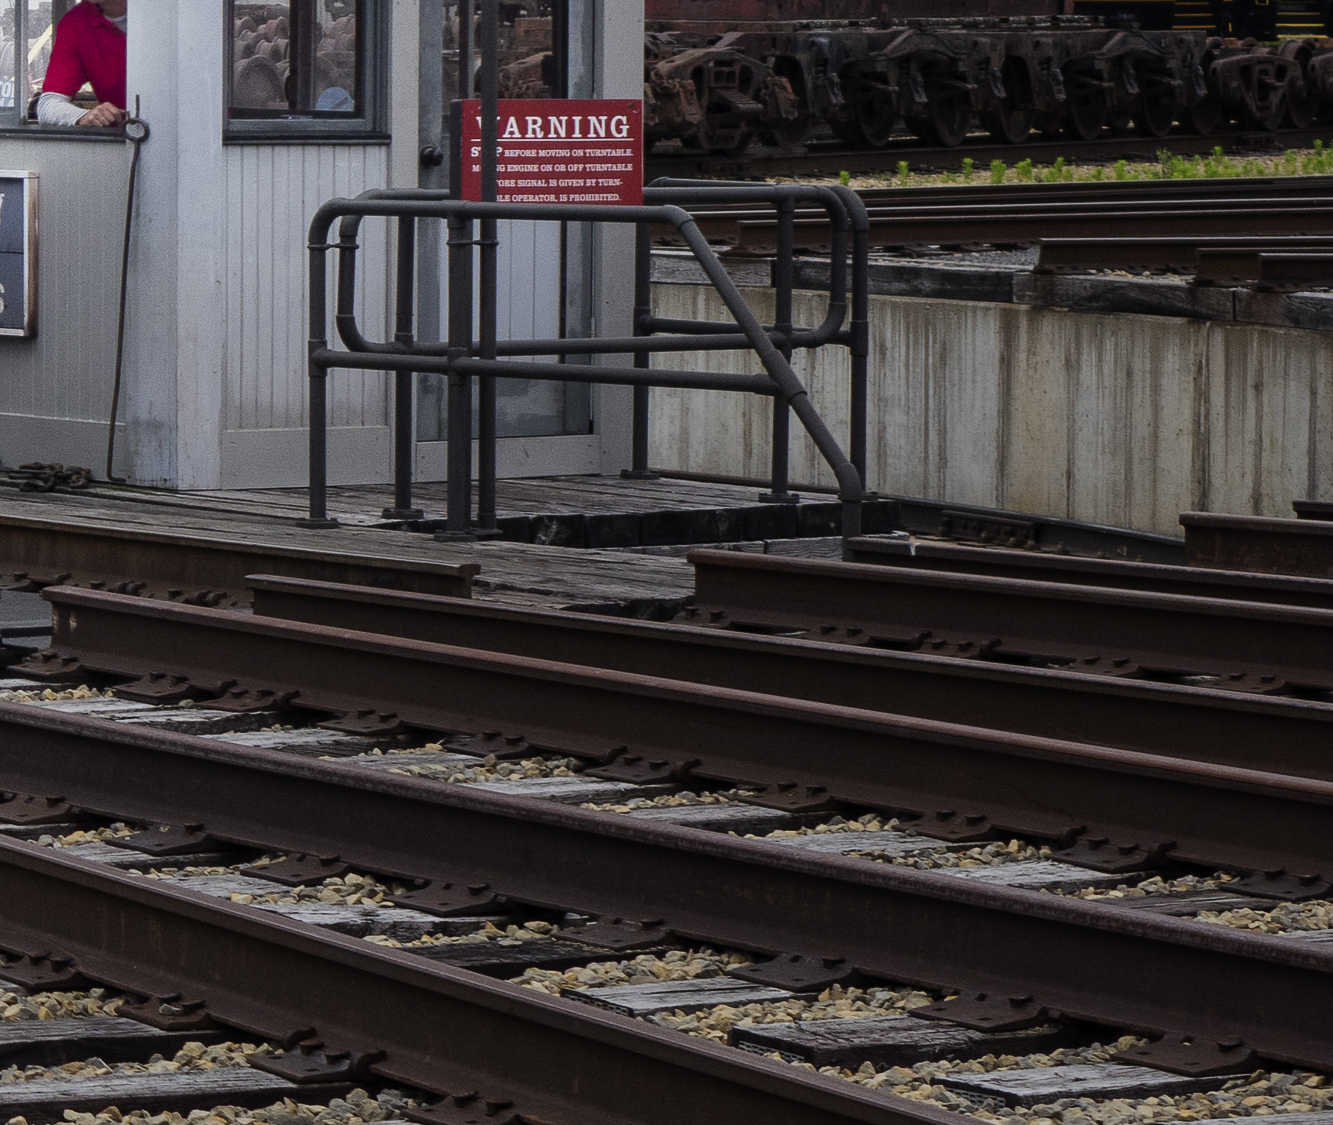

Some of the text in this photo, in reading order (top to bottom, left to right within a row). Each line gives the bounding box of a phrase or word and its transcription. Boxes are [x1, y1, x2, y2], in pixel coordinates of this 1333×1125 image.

[475, 115, 630, 139] ARNING
[471, 147, 634, 157] SP BEFORE MOVING ON TURNTABLE.
[507, 164, 539, 172] ENGINE
[540, 164, 553, 172] ON
[554, 164, 567, 172] OR
[585, 163, 633, 171] TURNTABLE
[517, 179, 548, 187] SIGNAL
[549, 179, 557, 187] IS
[558, 179, 584, 187] GIVEN
[597, 178, 623, 186] TURN-
[511, 194, 558, 203] OPERATOR,
[569, 194, 621, 202] PROHIBITED.
